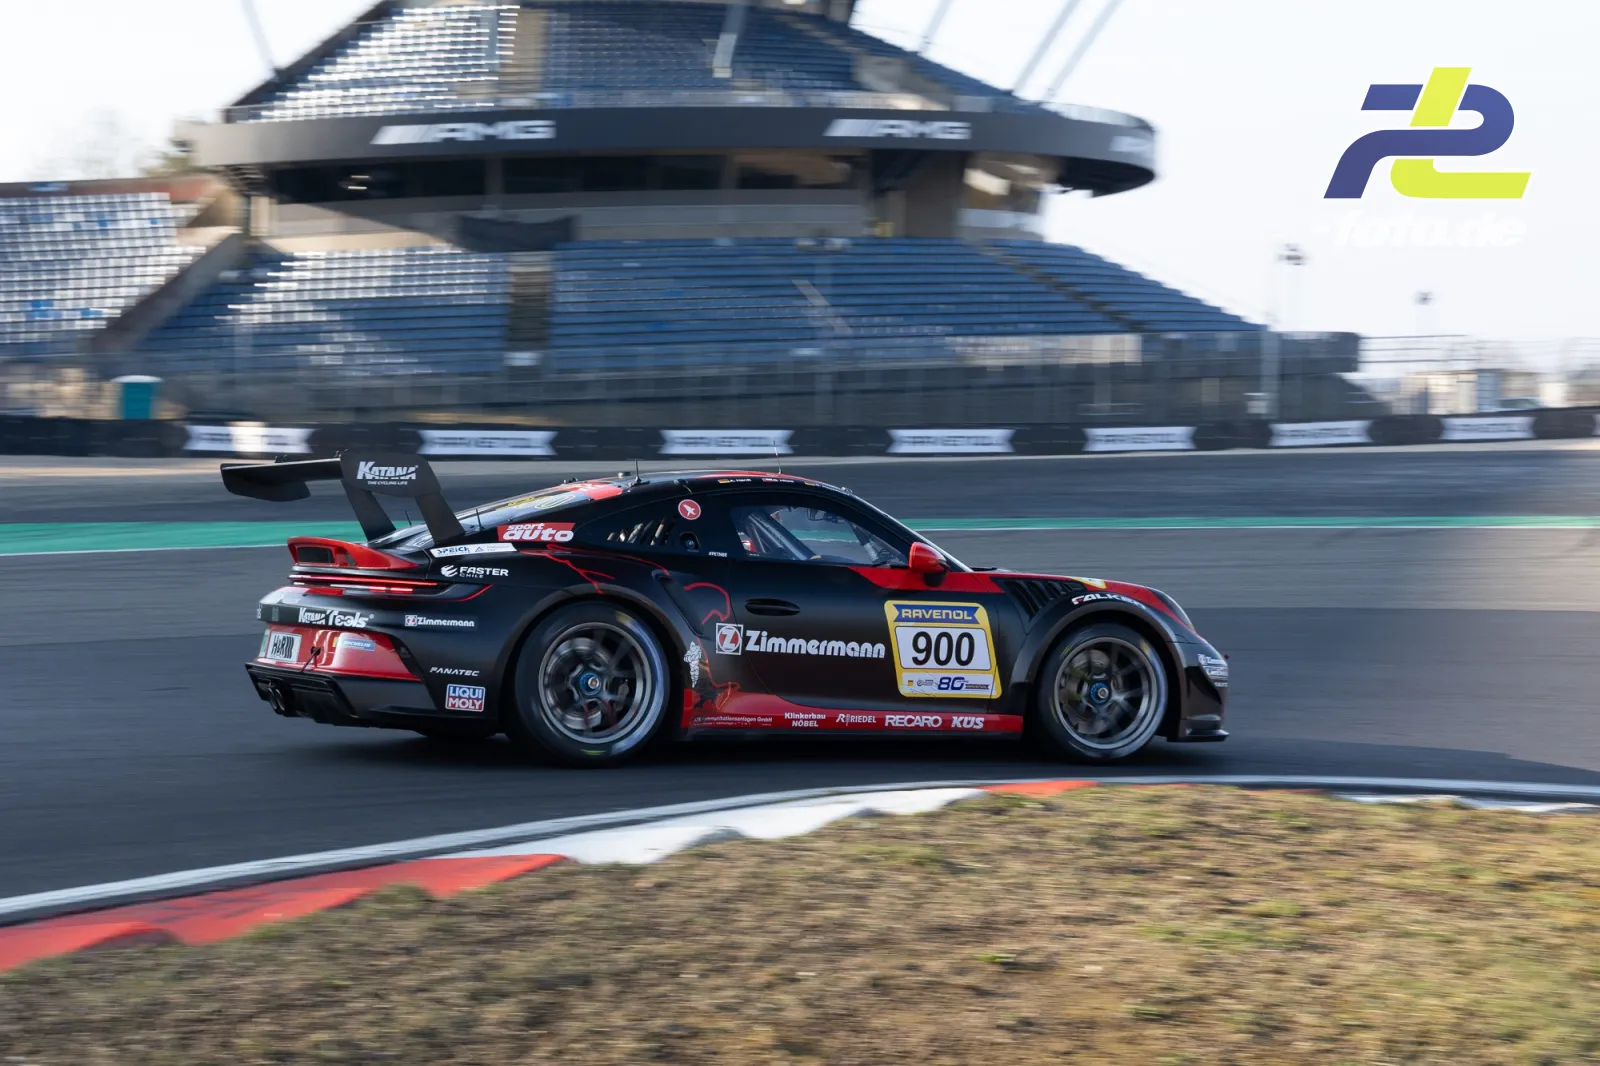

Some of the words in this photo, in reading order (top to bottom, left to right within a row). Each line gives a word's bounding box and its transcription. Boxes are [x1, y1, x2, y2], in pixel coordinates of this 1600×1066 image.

[356, 461, 417, 480] KATANA
[507, 523, 544, 531] sport
[503, 528, 574, 542] auto
[459, 566, 509, 577] FASTER
[901, 609, 972, 620] RAVENOL
[417, 617, 475, 627] Zimmermann
[746, 630, 886, 658] Zimmermann
[912, 631, 975, 666] 900
[430, 667, 479, 676] FANATEC
[449, 687, 483, 698] LIQUI
[448, 698, 482, 709] MOLY
[792, 719, 818, 727] NÖBEL
[885, 715, 942, 727] RECARO
[951, 716, 984, 729] KÜS
